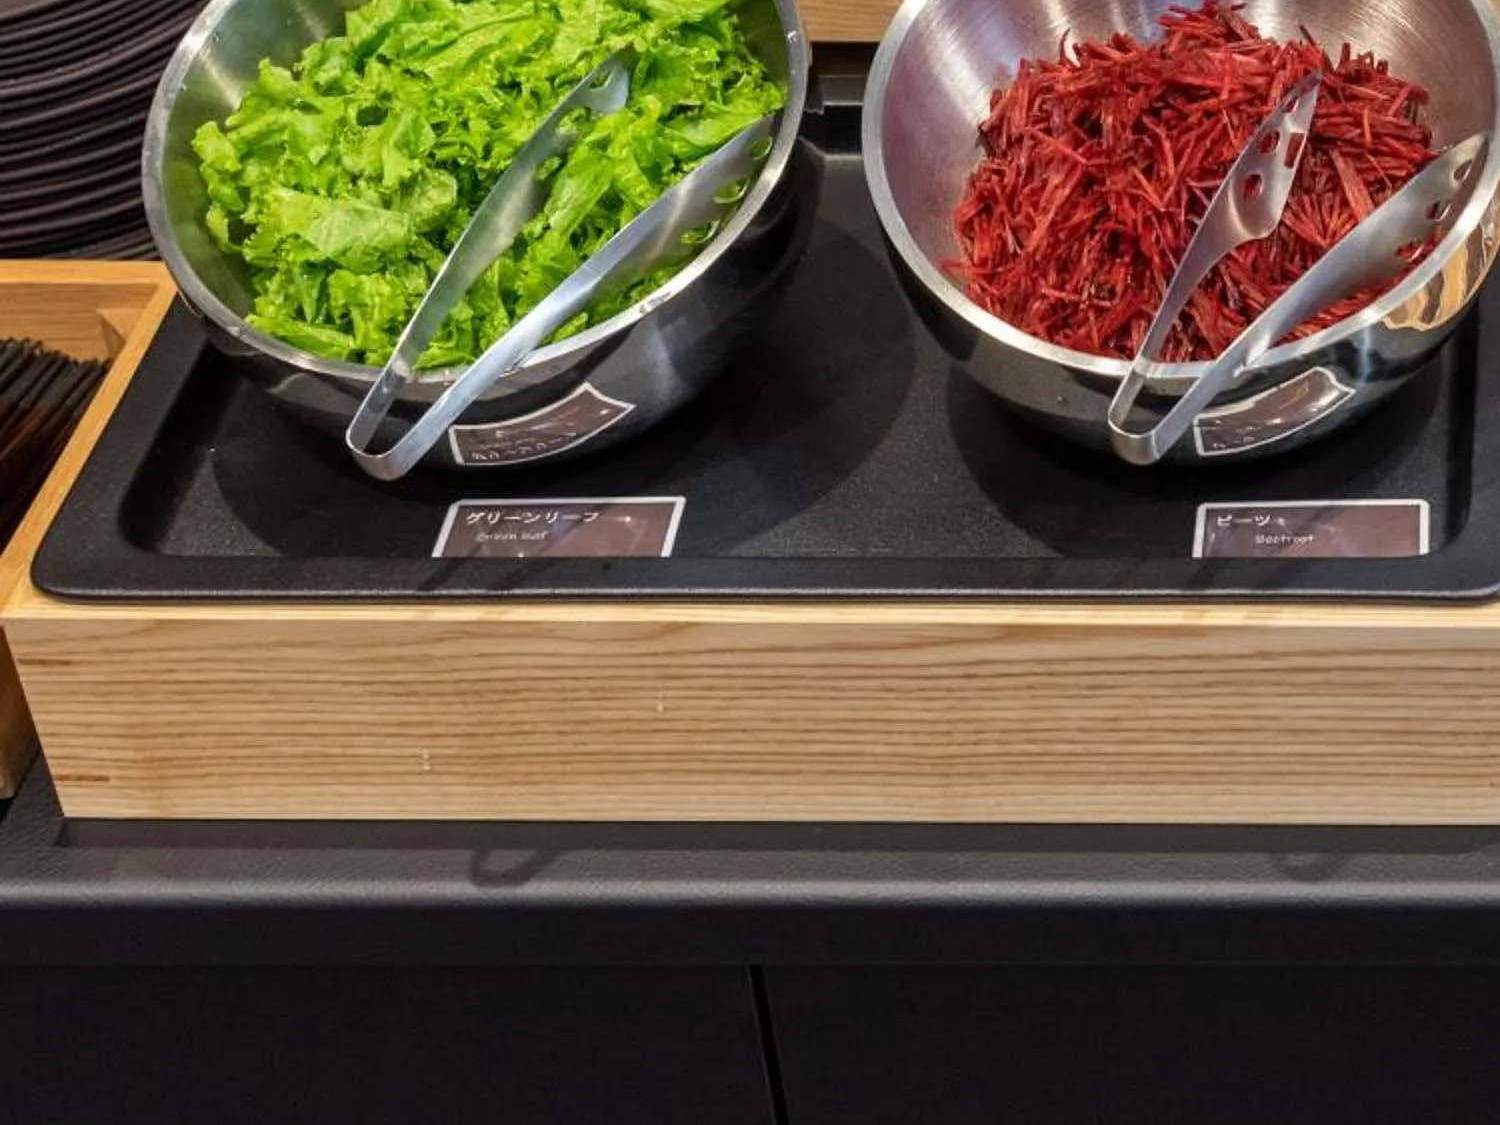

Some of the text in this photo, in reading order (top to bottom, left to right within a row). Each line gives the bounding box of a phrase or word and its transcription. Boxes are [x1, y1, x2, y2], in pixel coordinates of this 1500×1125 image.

[466, 511, 599, 524] グリーンリーフ
